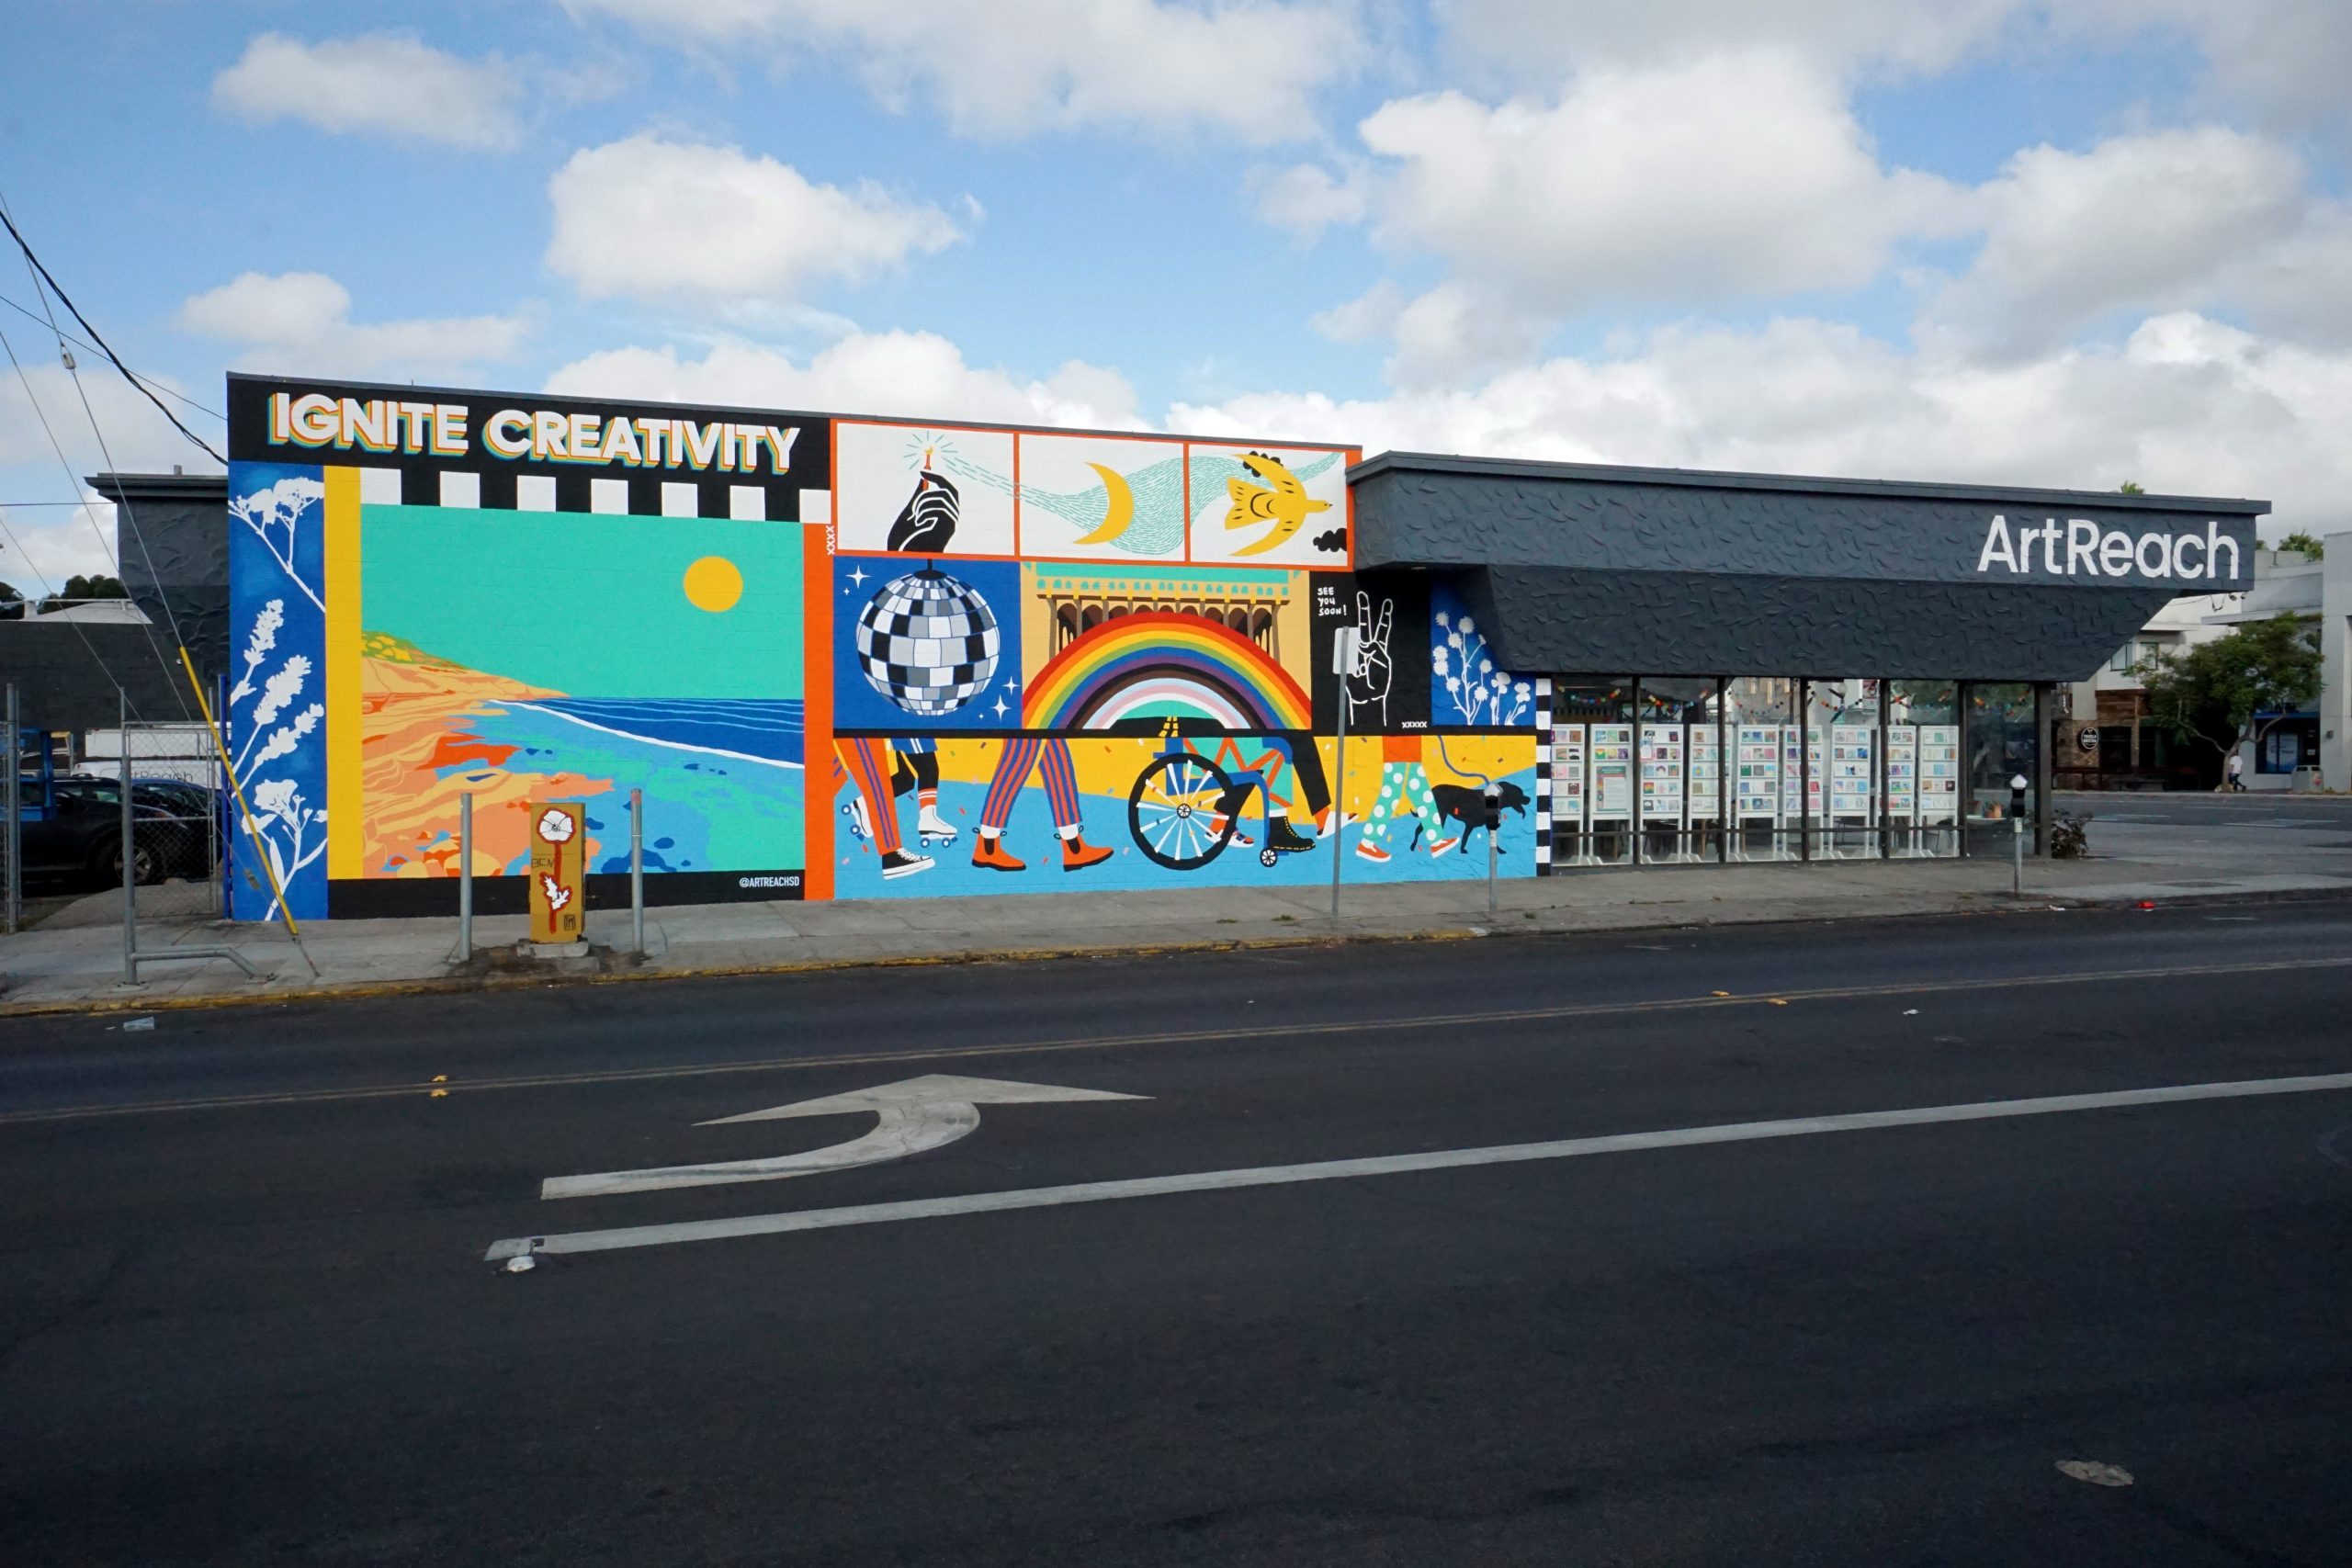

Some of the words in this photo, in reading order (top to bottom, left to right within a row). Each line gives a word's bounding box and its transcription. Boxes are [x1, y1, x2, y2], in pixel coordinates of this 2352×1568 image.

[268, 391, 469, 456] IGNITE
[482, 410, 800, 475] CREATIVITY
[1977, 515, 2239, 580] ArtReach
[1317, 586, 1334, 595] SEE
[1317, 597, 1336, 607] YOU
[1318, 604, 1347, 616] SOON!
[741, 876, 800, 887] @ARTREACHSD
